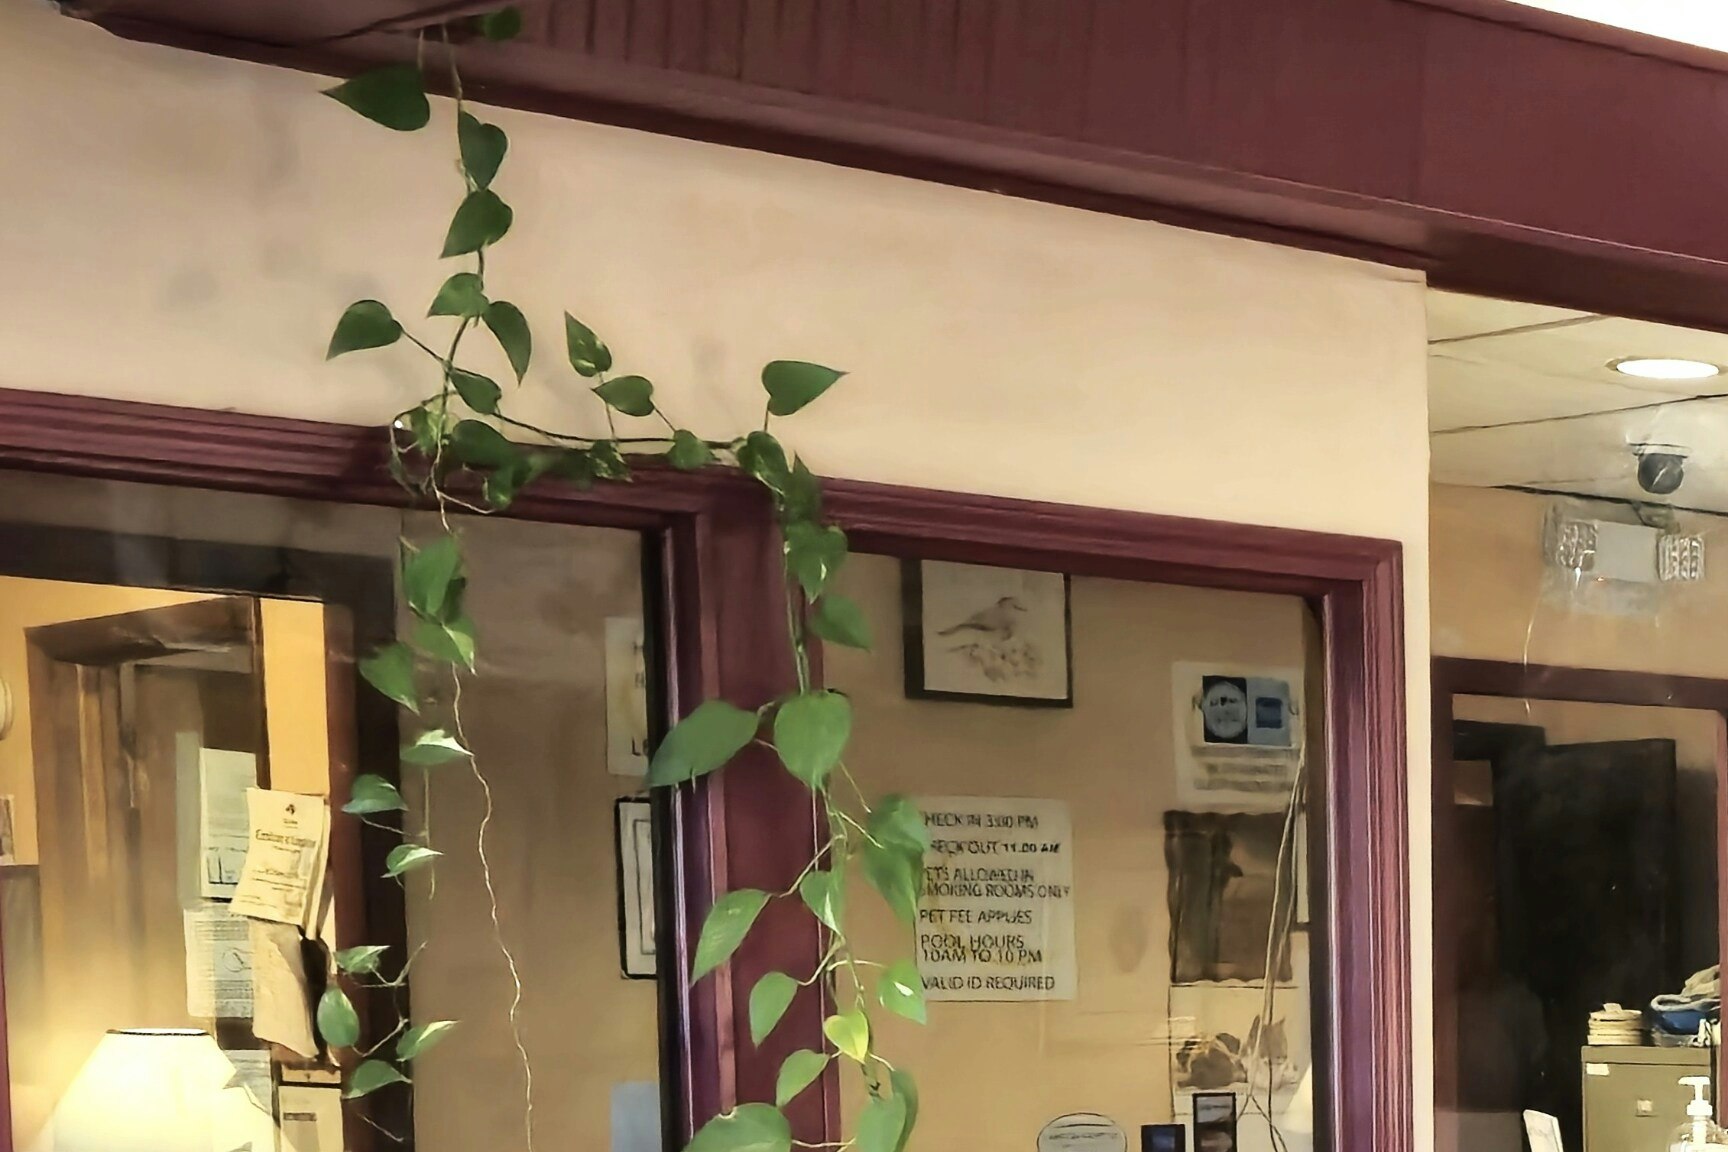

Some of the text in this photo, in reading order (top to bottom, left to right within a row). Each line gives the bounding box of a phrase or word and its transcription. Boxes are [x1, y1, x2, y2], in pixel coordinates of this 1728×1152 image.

[924, 811, 962, 827] HECK
[924, 866, 949, 882] ETS
[985, 884, 1034, 899] ROOMS
[1037, 884, 1071, 899] ONLY
[919, 909, 1033, 925] PET FEE APPLIES
[920, 934, 1025, 950] POOL HOURS
[970, 949, 992, 963] TO
[1018, 949, 1043, 963] PM
[920, 975, 1056, 991] VALID ID REQUIRED
